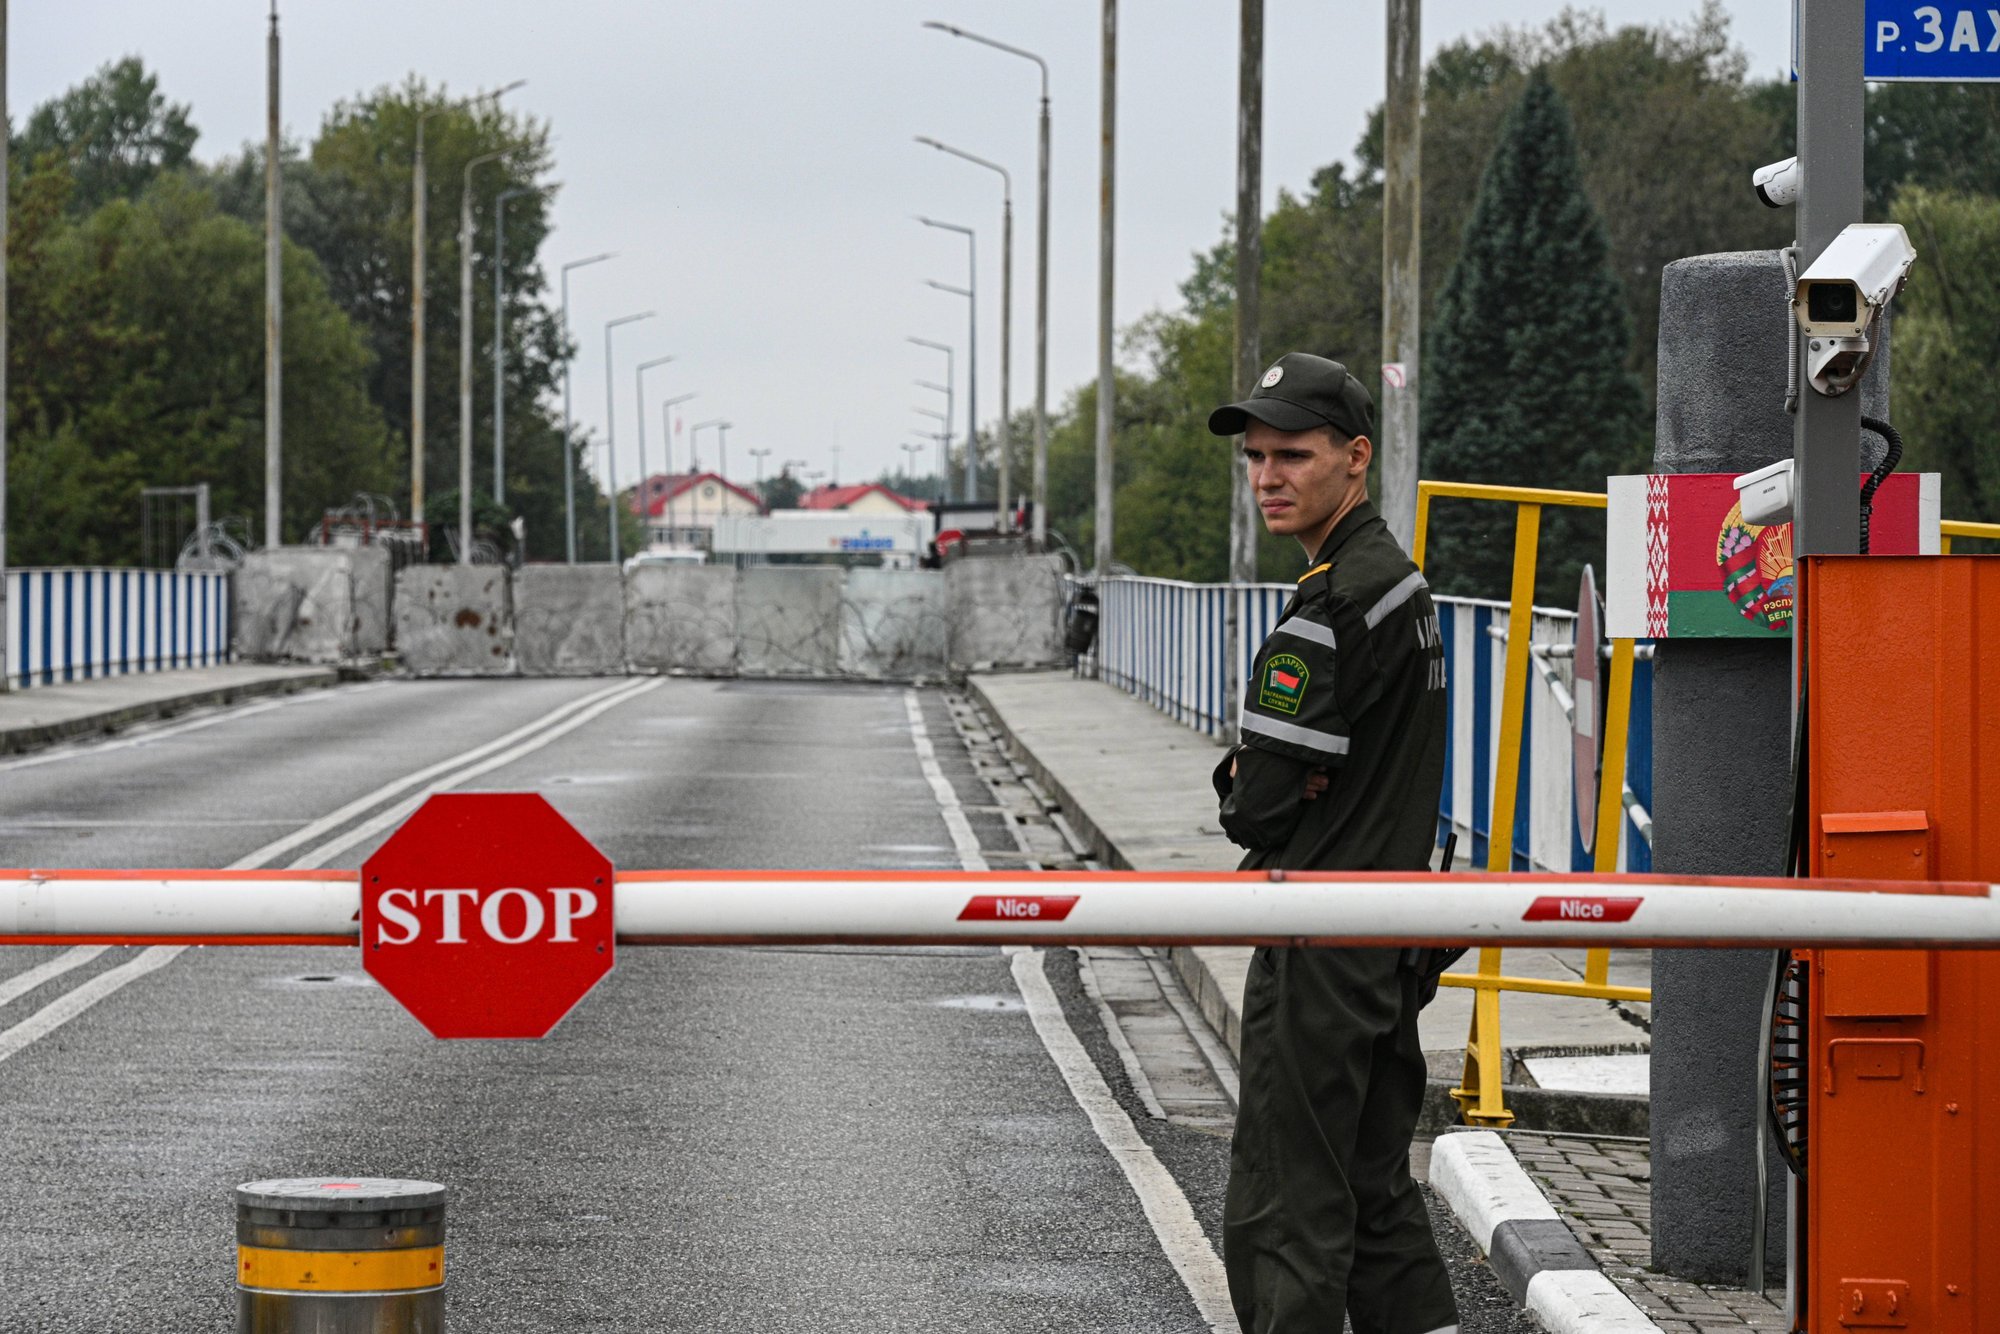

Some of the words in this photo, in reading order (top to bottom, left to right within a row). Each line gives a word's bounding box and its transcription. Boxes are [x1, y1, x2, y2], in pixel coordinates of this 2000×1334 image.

[377, 888, 598, 945] STOP
[996, 898, 1040, 917] Nice
[1560, 900, 1604, 918] Nice
